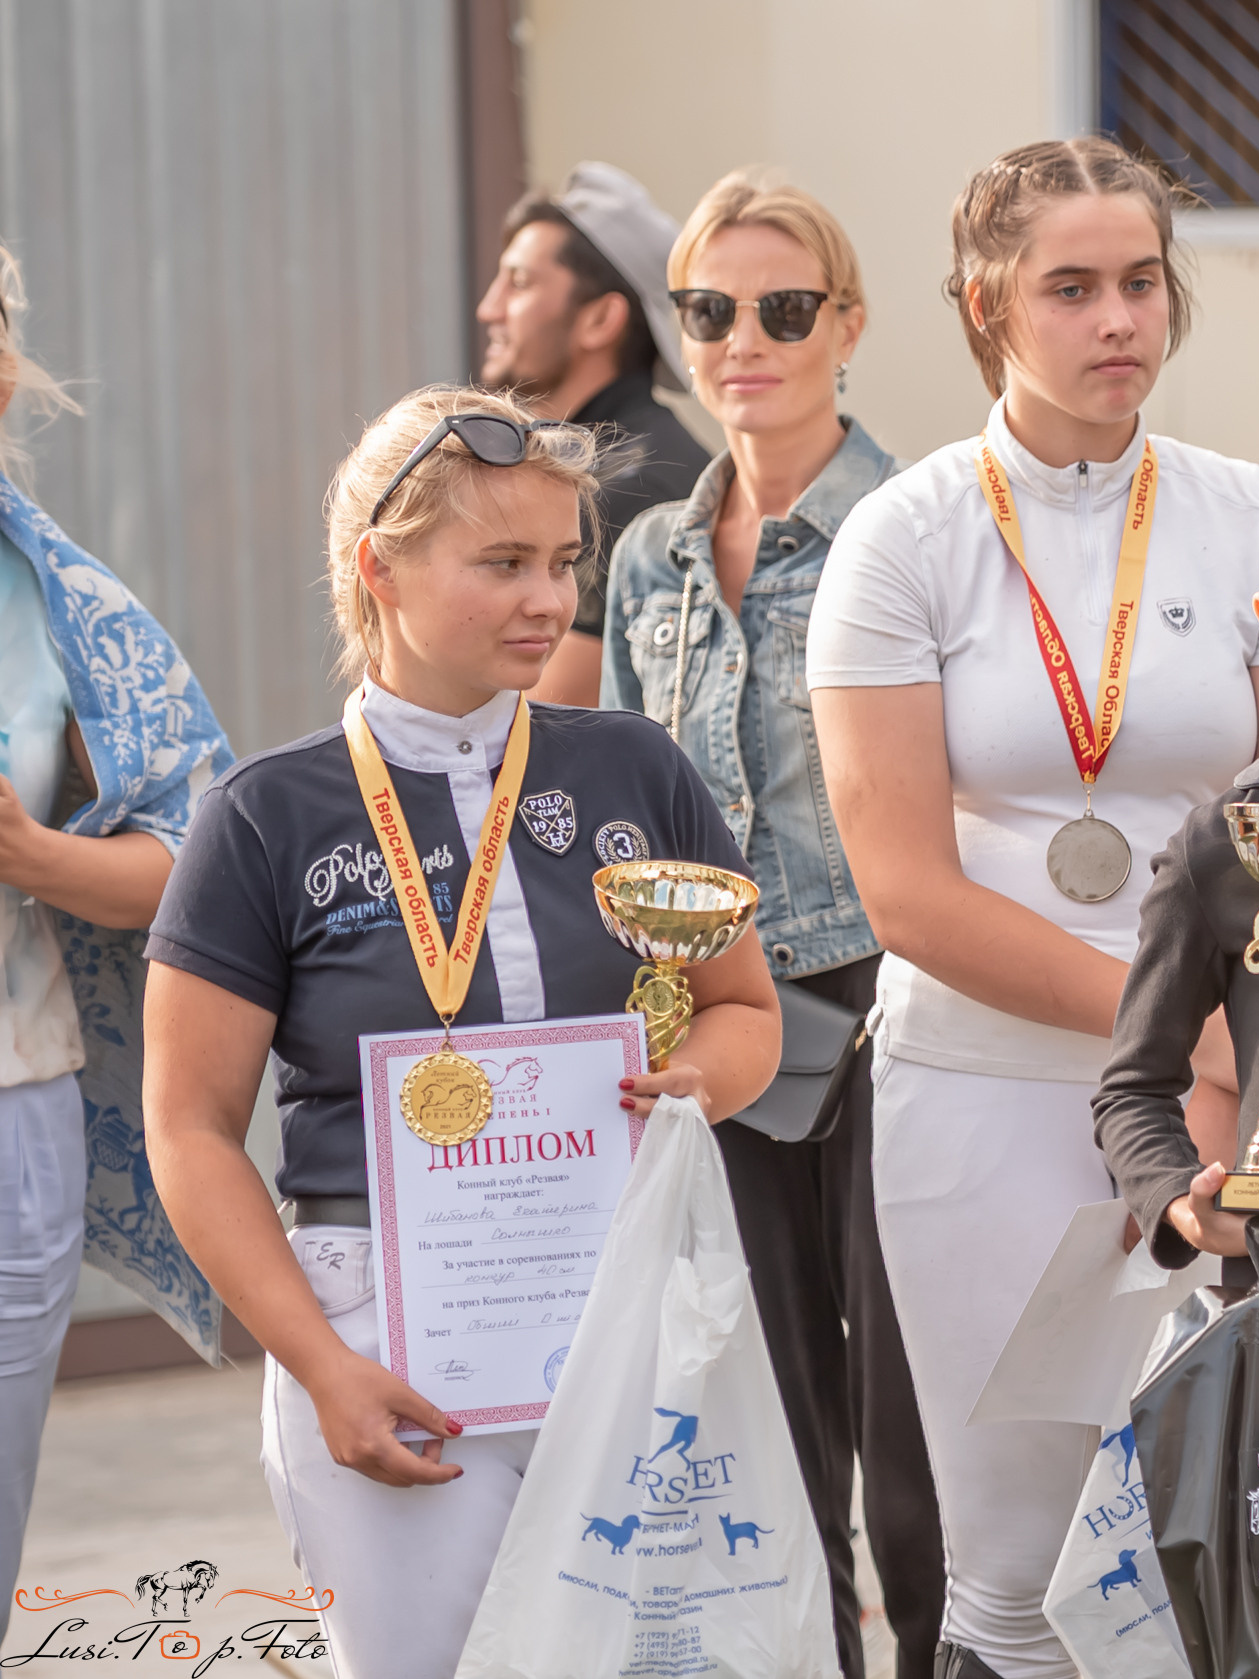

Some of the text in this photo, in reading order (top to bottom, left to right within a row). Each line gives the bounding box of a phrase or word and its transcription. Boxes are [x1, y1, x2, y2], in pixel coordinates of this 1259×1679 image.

[1101, 600, 1134, 749] Тверская Облас
[528, 795, 562, 810] POLO
[537, 804, 559, 817] TEAM
[557, 817, 573, 829] 85
[612, 832, 634, 858] 3
[372, 787, 437, 968] Тверская область
[454, 796, 511, 966] Тверская область
[427, 1129, 597, 1173] ДИПЛОМ
[457, 1172, 570, 1190] Конный клуб «Резвая»
[483, 1188, 545, 1203] награждает:
[417, 1237, 473, 1251] На лошади
[442, 1260, 454, 1270] За
[457, 1256, 496, 1271] участие
[507, 1252, 581, 1267] соревнованиях
[584, 1250, 597, 1258] по
[457, 1299, 480, 1310] приз
[482, 1296, 525, 1306] Конного
[527, 1292, 556, 1303] клуба
[559, 1289, 590, 1299] «Резва
[424, 1328, 451, 1338] Зачет
